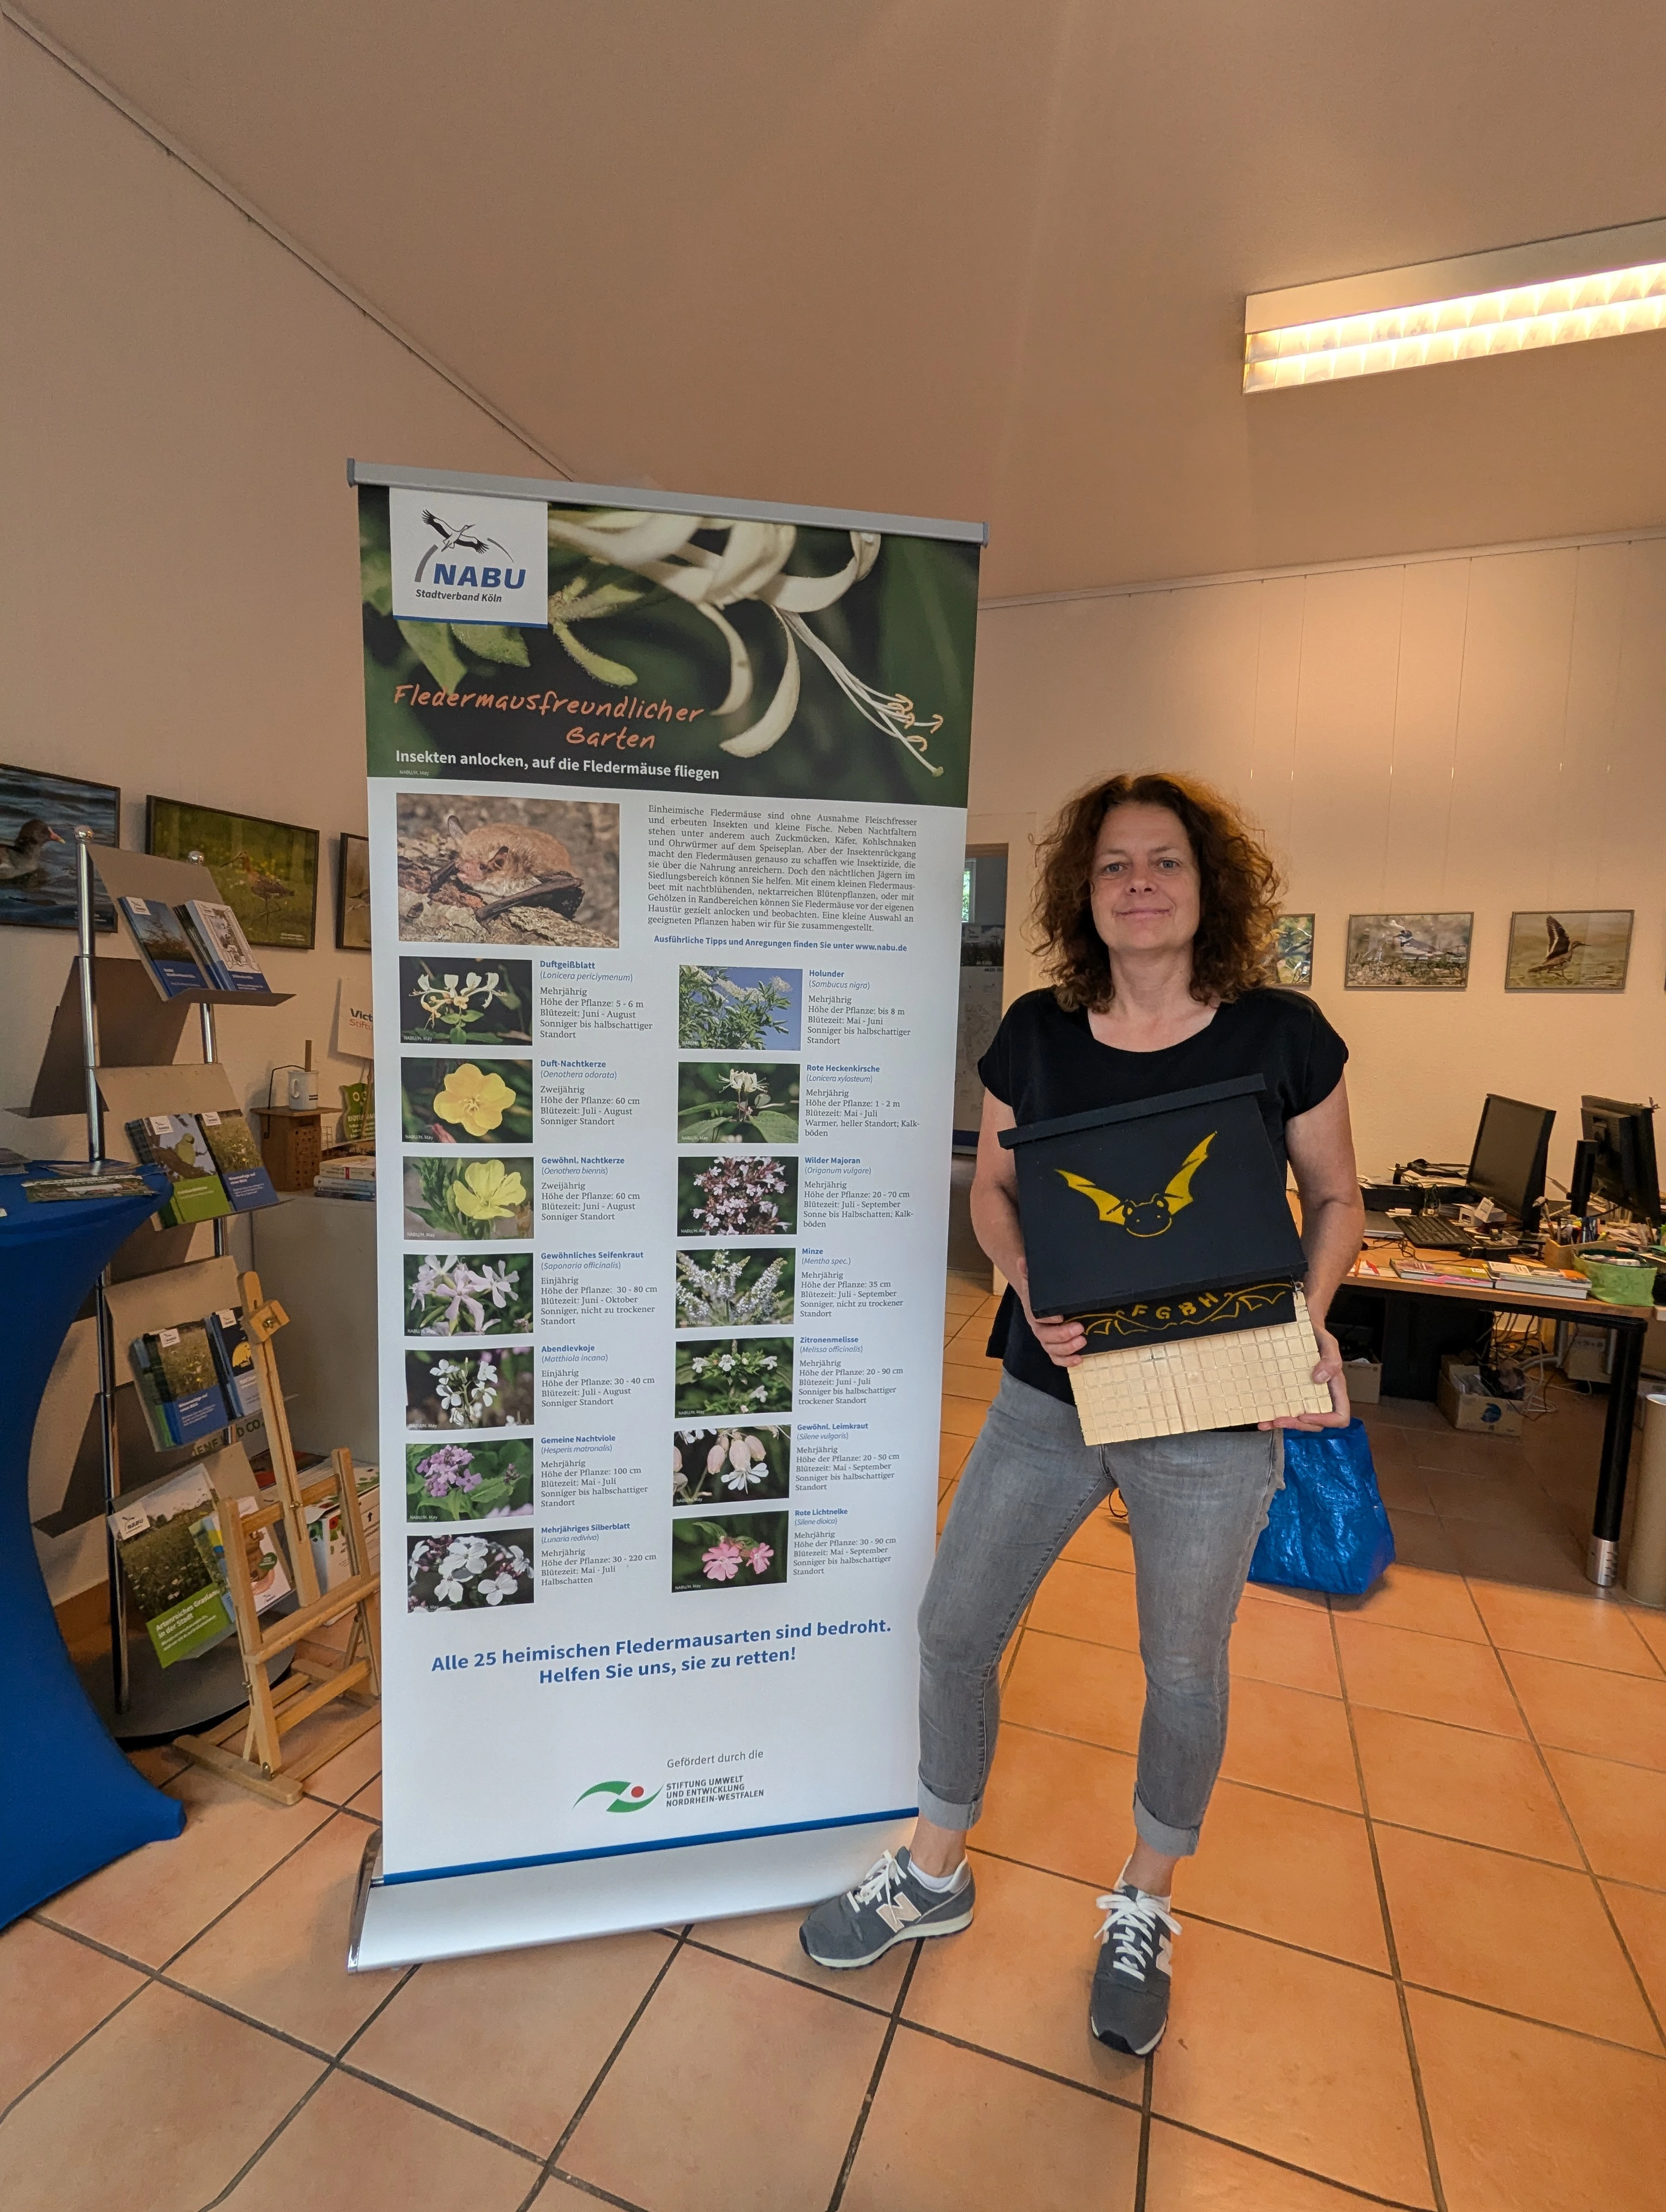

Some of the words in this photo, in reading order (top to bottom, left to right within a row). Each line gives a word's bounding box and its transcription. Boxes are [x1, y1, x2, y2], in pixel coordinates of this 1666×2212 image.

[433, 563, 527, 589] NABU
[415, 589, 480, 602] Stadtverband
[481, 593, 502, 602] Köln
[394, 684, 704, 723] Fledermausfreundlicher
[566, 726, 656, 750] Garten
[396, 750, 456, 764] Insekten
[460, 753, 528, 770] anlocken,
[532, 756, 556, 769] auf
[558, 757, 580, 771] die
[584, 760, 671, 776] Fledermäuse
[674, 764, 719, 781] fliegen
[649, 805, 704, 815] Einheimische
[710, 808, 761, 819] Fledermäuse
[767, 811, 785, 820] sind
[790, 812, 811, 821] ohne
[817, 814, 860, 823] Ausnahme
[865, 815, 917, 826] Fleischfresser
[648, 816, 665, 824] und
[670, 817, 707, 827] erbeuten
[713, 819, 748, 829] Insekten
[753, 822, 769, 830] und
[775, 822, 800, 831] kleine
[805, 824, 832, 833] Fische.
[837, 825, 863, 834] Neben
[868, 827, 917, 837] Nachtfaltern
[648, 827, 676, 836] stehen
[709, 831, 745, 840] anderem
[750, 833, 770, 841] auch
[776, 833, 830, 844] Zuckmücken,
[835, 836, 857, 845] Käfer,
[862, 837, 917, 847] Kohlschnaken
[648, 838, 665, 846] und
[668, 839, 718, 850] Ohrwürmer
[721, 842, 736, 850] auf
[738, 843, 756, 851] dem
[759, 844, 804, 854] Speiseplan.
[807, 846, 827, 854] Aber
[830, 846, 843, 855] der
[847, 847, 917, 860] Insektenrückgang
[648, 915, 692, 925] geeigneten
[694, 917, 729, 926] Pflanzen
[731, 918, 755, 927] haben
[758, 919, 772, 928] wir
[773, 920, 786, 928] für
[787, 921, 799, 929] Sie
[801, 923, 874, 933] zusammengestellt.
[654, 935, 704, 944] Ausführliche
[705, 937, 727, 947] Tipps
[745, 938, 792, 949] Anregungen
[793, 940, 818, 948] finden
[855, 943, 907, 951] www.nabu.de
[540, 960, 595, 970] Duftgeißblatt
[540, 970, 575, 980] (Lonicera
[809, 969, 845, 978] Holunder
[809, 980, 848, 988] (Sambucus
[540, 987, 587, 998] Mehrjährig
[540, 1019, 578, 1030] Sonniger
[579, 1020, 592, 1028] bis
[594, 1020, 653, 1031] halbschattiger
[540, 1030, 576, 1038] Standort
[540, 1059, 606, 1068] Duft-Nachtkerze
[826, 1065, 880, 1073] Heckenkirsche
[540, 1070, 584, 1079] (Oenothera
[540, 1085, 585, 1095] Zweijährig
[540, 1096, 563, 1104] Höhe
[581, 1096, 613, 1104] Pflanze:
[540, 1117, 578, 1127] Sonniger
[579, 1117, 615, 1126] Standort
[805, 1119, 838, 1127] Warmer,
[864, 1120, 899, 1128] Standort;
[830, 1156, 861, 1165] Majoran
[804, 1166, 842, 1175] (Origanum
[541, 1251, 597, 1259] Gewöhnliches
[541, 1307, 579, 1316] Sonniger,
[617, 1306, 656, 1314] trockener
[541, 1344, 595, 1353] Abendlevkoje
[541, 1436, 574, 1444] Gemeine
[541, 1470, 562, 1478] Höhe
[541, 1525, 589, 1534] Mehrjähriges
[591, 1523, 630, 1531] Silberblatt
[541, 1577, 593, 1586] Halbschatten
[431, 1654, 469, 1671] Alle
[474, 1651, 496, 1667] 25
[503, 1643, 610, 1664] heimischen
[616, 1630, 771, 1655] Fledermausarten
[776, 1622, 812, 1639] sind
[817, 1619, 891, 1636] bedroht.
[540, 1667, 600, 1684] Helfen
[605, 1663, 633, 1679] Sie
[638, 1662, 676, 1676] uns,
[681, 1655, 706, 1671] sie
[711, 1656, 731, 1668] zu
[736, 1647, 796, 1666] retten!
[667, 1755, 715, 1768] Gefördert
[717, 1751, 746, 1763] durch
[748, 1750, 764, 1759] die
[666, 1779, 707, 1791] STIFTUNG
[709, 1775, 744, 1786] UMWELT
[667, 1790, 684, 1799] UND
[686, 1784, 745, 1797] ENTWICKLUNG
[666, 1789, 764, 1808] NORDRHEIN-WESTFALEN
